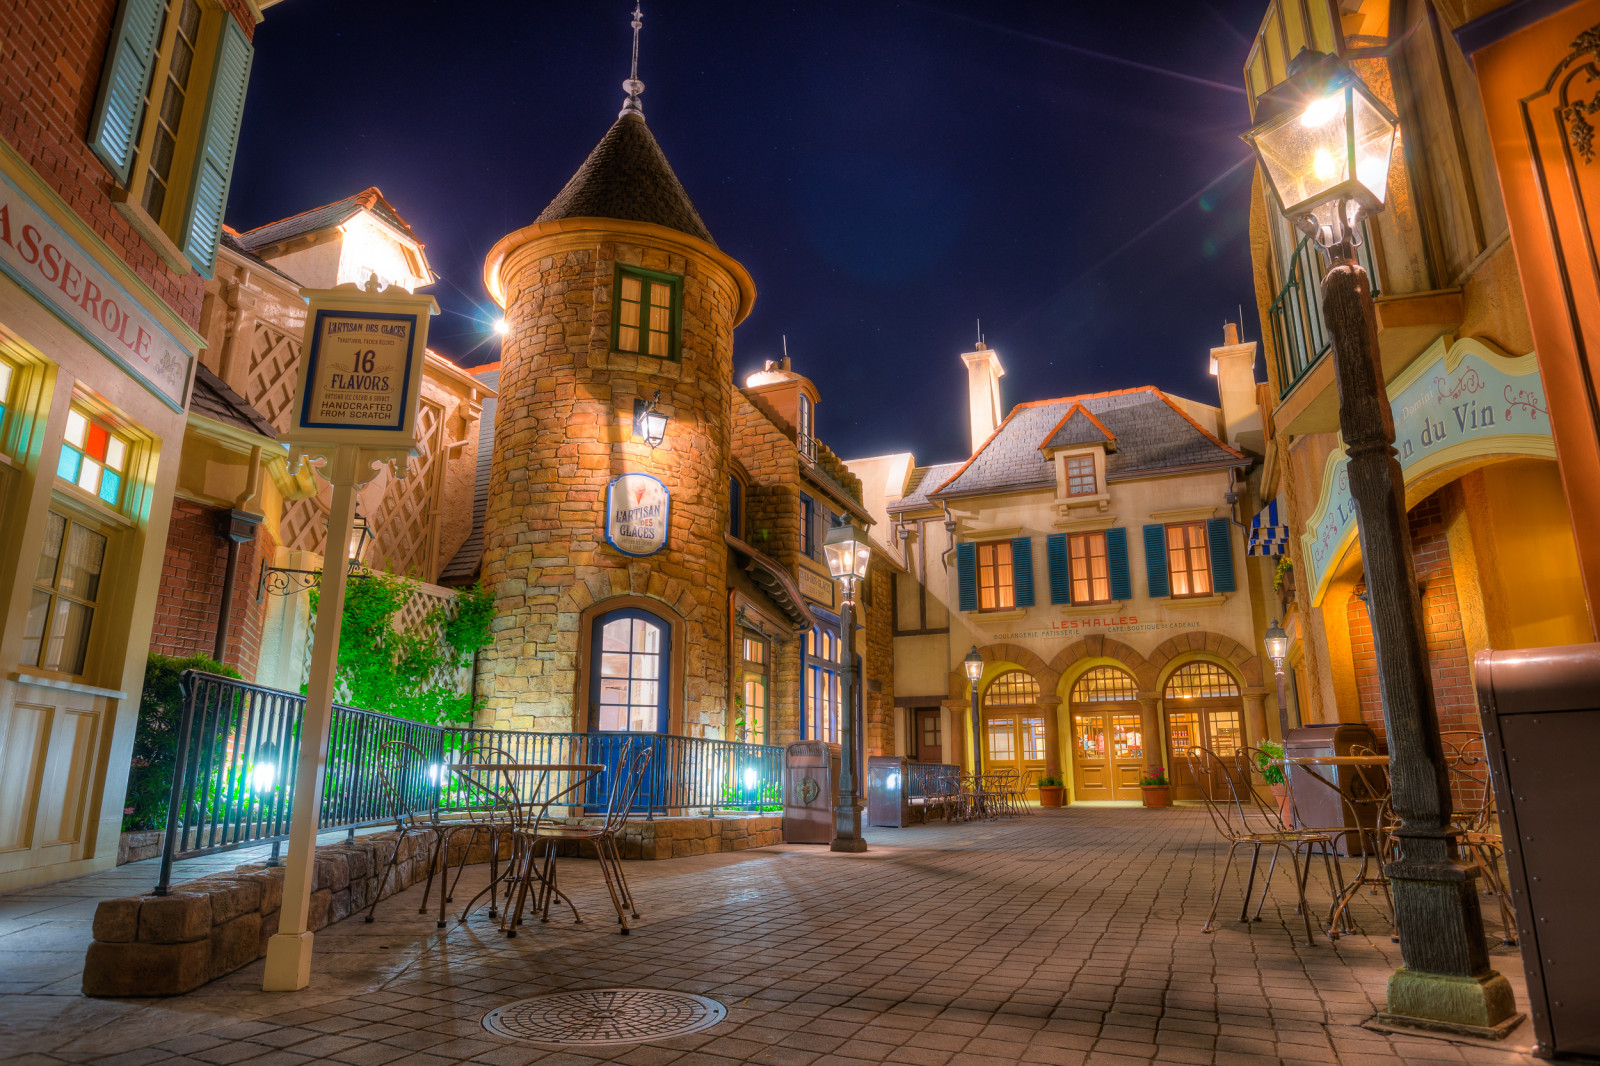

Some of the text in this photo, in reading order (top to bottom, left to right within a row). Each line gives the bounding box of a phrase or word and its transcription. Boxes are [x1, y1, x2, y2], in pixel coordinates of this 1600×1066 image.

[328, 321, 406, 339] L'ARTISAN DES GLACES
[352, 349, 376, 374] 16
[331, 374, 389, 391] FLAVORS
[321, 401, 393, 412] HANDCRAFTED
[1402, 384, 1435, 420] Domini
[320, 409, 392, 420] FROM SCRATCH
[1421, 415, 1447, 448] du
[1452, 400, 1496, 434] Vin
[615, 504, 661, 523] L'ARTISAN
[640, 518, 653, 527] DES
[619, 524, 655, 539] GLACES
[1052, 616, 1138, 630] LES HALLES
[1127, 624, 1160, 632] BOUTIQUE
[1169, 621, 1201, 629] CADEAUX
